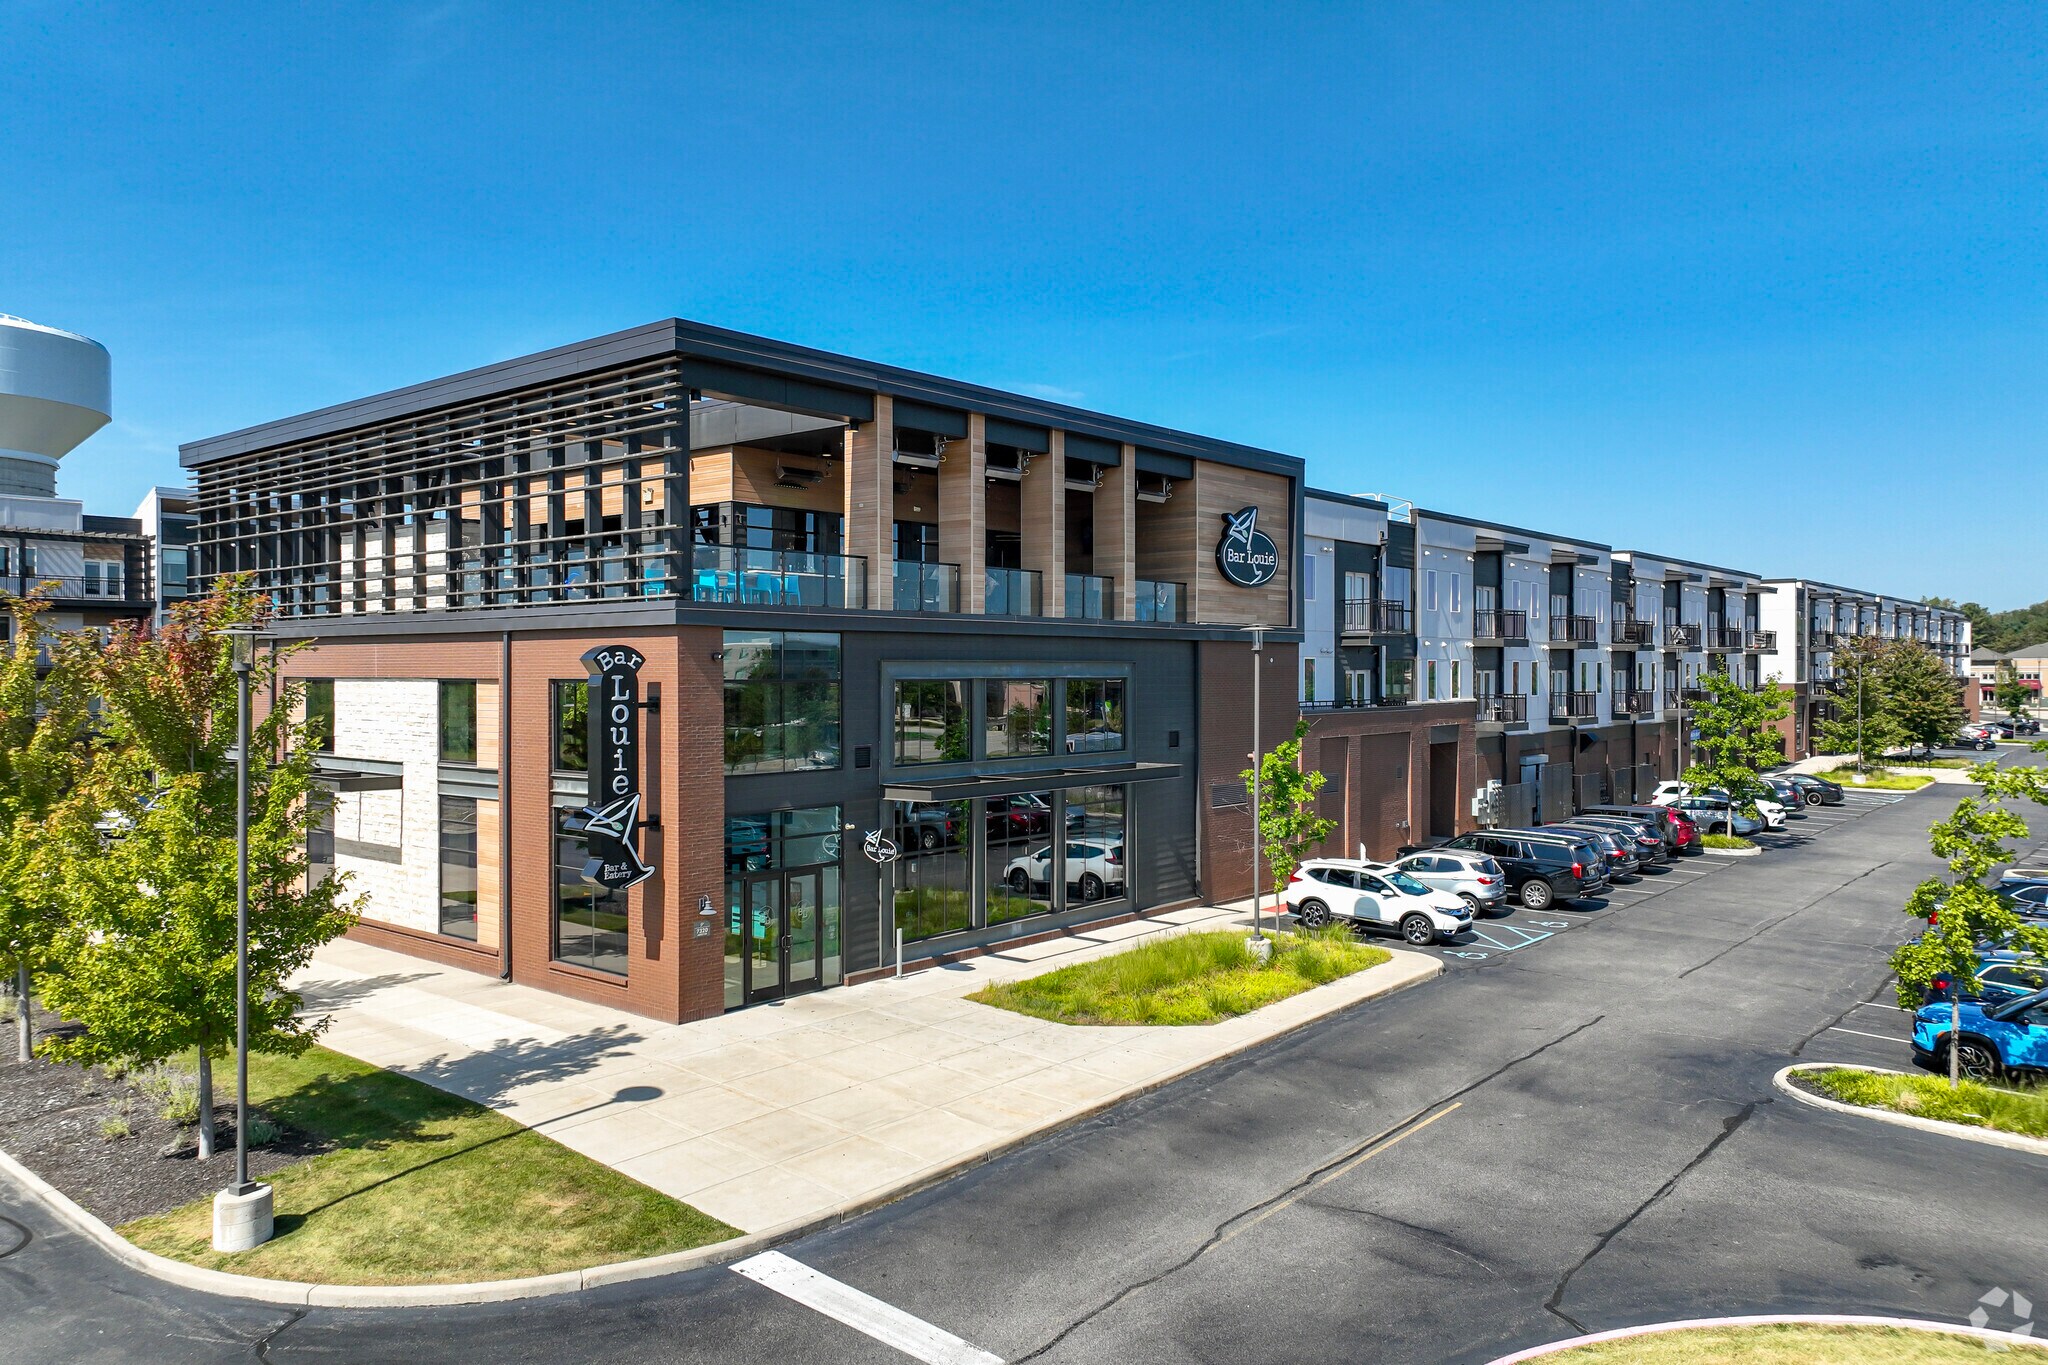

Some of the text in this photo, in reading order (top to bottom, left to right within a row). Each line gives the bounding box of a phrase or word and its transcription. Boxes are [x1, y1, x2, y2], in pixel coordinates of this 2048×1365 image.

[1227, 549, 1275, 566] Bar Louie
[597, 651, 642, 671] Bar
[611, 675, 630, 795] Louie
[866, 844, 895, 855] Bar Louie
[604, 861, 628, 873] Bar &
[604, 870, 632, 880] Eatery
